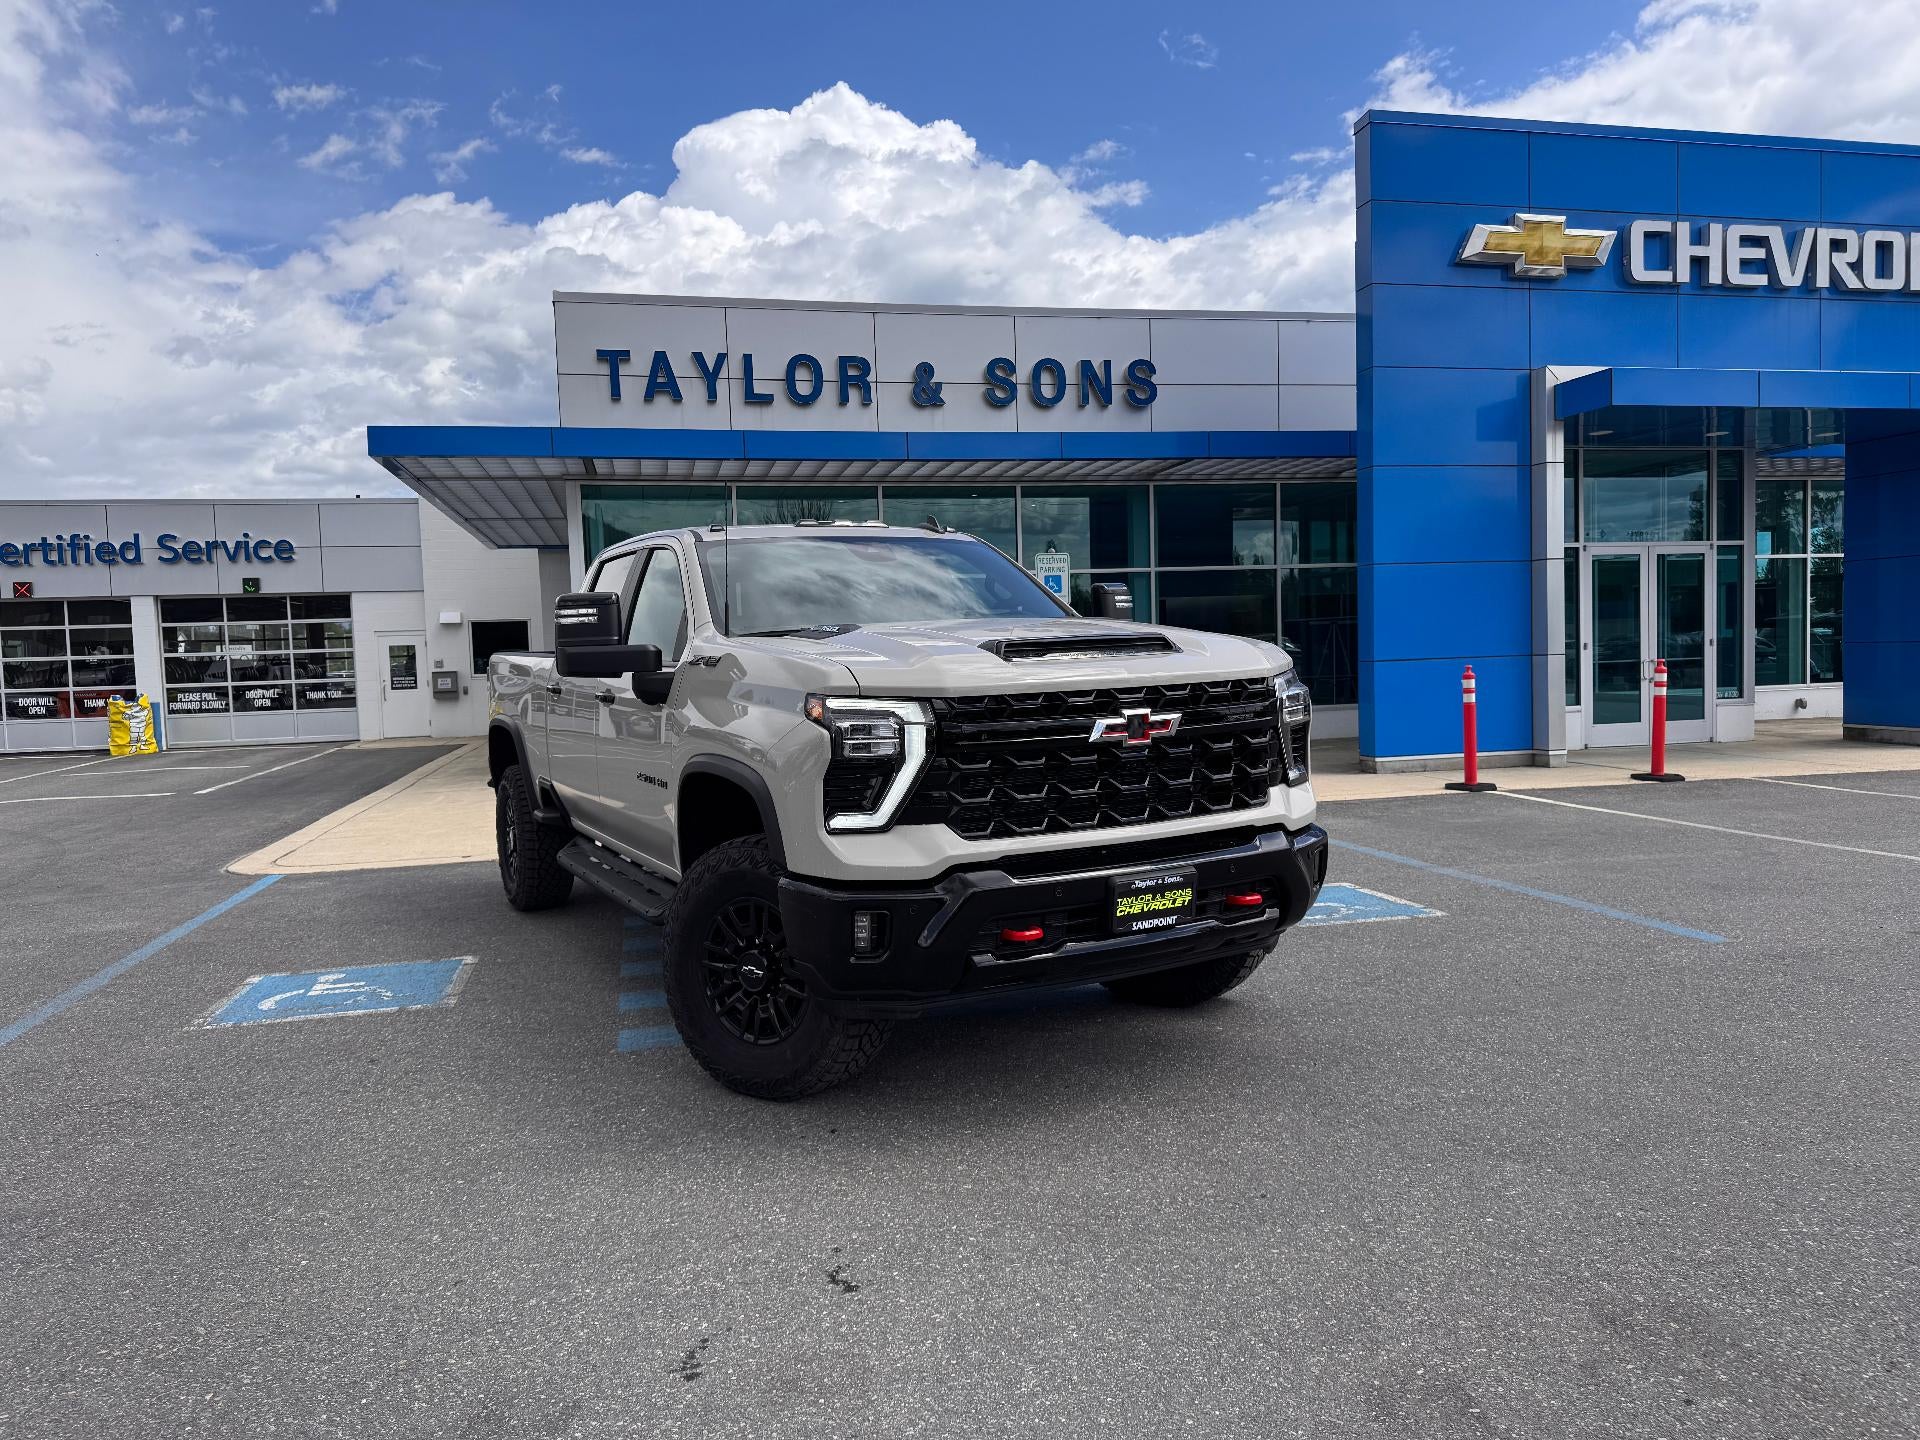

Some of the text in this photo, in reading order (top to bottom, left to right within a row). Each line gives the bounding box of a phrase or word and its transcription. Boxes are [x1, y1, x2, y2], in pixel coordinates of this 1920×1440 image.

[1623, 219, 1920, 291] CHEVRO
[596, 348, 1159, 408] TAYLOR & SONS
[157, 532, 295, 564] Service
[1038, 557, 1067, 565] RESERVED
[177, 692, 218, 702] PLEASE PULL
[245, 689, 279, 699] DOOR WILL
[305, 691, 327, 699] THANK
[18, 697, 55, 707] DOOR WILL
[83, 698, 106, 708] THANK
[169, 701, 226, 710] FORWARD SLOWLY
[254, 699, 271, 707] OPEN
[28, 707, 46, 715] OPEN
[1135, 879, 1157, 889] Taylor
[1163, 875, 1180, 884] Sons
[1116, 894, 1153, 908] TAYLOR
[1164, 888, 1192, 899] SONS
[1116, 896, 1192, 917] CHEVROLET
[1131, 915, 1178, 931] SANDPOINT
